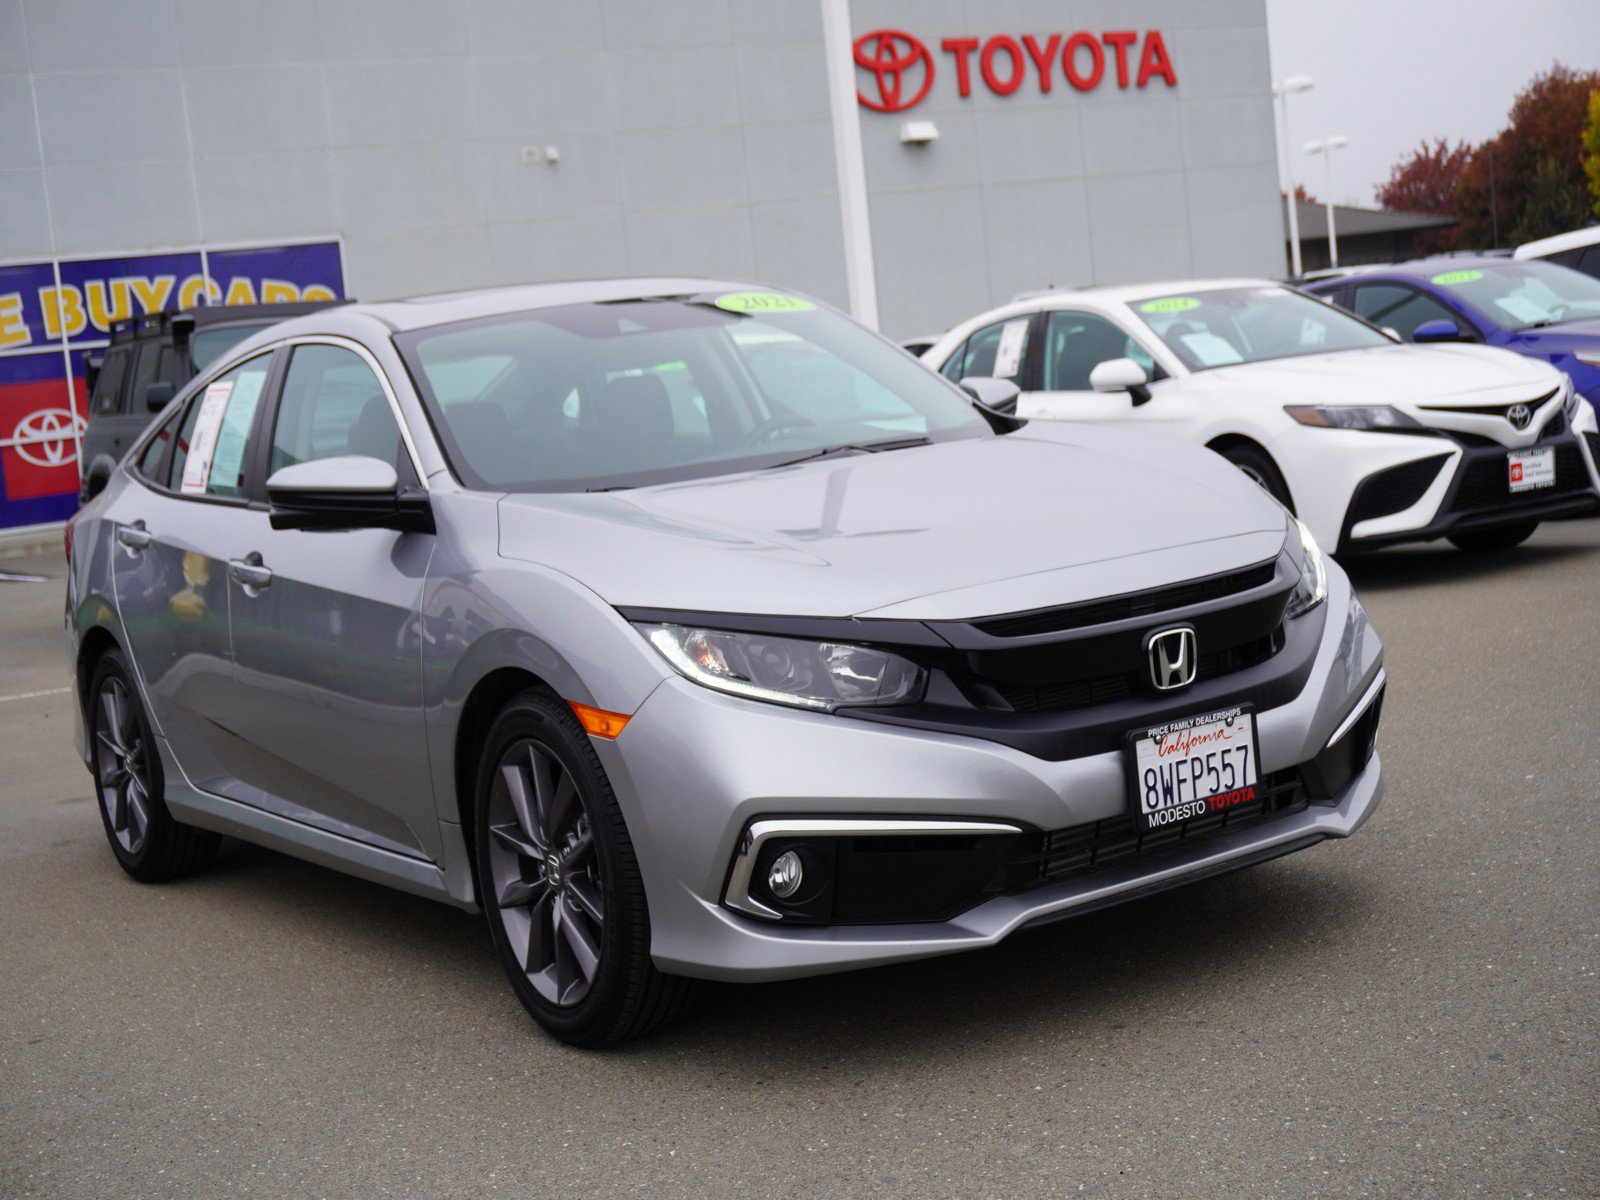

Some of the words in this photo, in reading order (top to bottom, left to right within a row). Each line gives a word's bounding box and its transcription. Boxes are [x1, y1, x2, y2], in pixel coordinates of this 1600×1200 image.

[941, 31, 1177, 97] TOYOTA
[39, 275, 176, 338] BUY
[736, 295, 795, 309] 2021
[1148, 726, 1169, 738] PRICE
[1170, 718, 1194, 732] FAMILY
[1196, 708, 1241, 724] DEALERSHIPS
[1158, 726, 1232, 757] California
[1144, 745, 1248, 809] 8WFP557
[1148, 800, 1206, 828] MODESTO
[1208, 787, 1256, 810] TOYOTA
